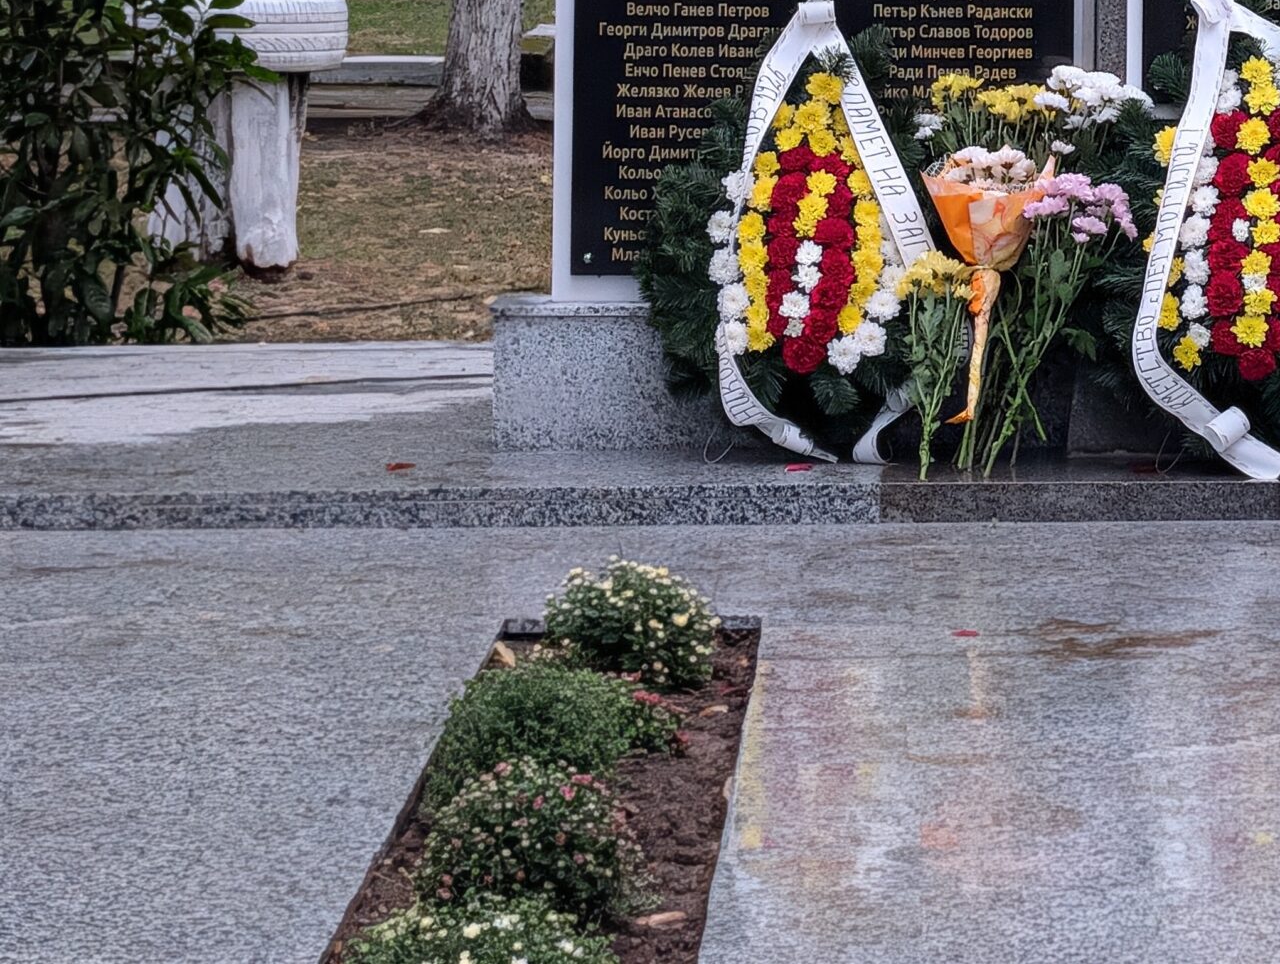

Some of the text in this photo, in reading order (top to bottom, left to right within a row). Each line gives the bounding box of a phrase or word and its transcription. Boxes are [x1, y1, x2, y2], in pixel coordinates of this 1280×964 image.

[626, 2, 769, 20] Велчо Ганев Петров
[873, 4, 1032, 20] Петър Кънев Радански
[599, 22, 647, 40] Георги
[651, 23, 724, 40] Димитров
[884, 24, 1033, 40] тър Славов Тодоров
[624, 43, 667, 60] Драго
[671, 43, 714, 57] Колев
[911, 45, 965, 59] Минчев
[969, 45, 1032, 61] Георгиев
[625, 63, 746, 78] Енчо Пенев Стоя
[889, 65, 923, 80] Ради
[974, 65, 1016, 80] Радев
[616, 83, 680, 98] Желязко
[684, 84, 731, 98] Желев
[616, 105, 712, 119] Иван Атанасо
[630, 125, 664, 139] Иван
[602, 141, 700, 162] Йорго Димит
[844, 92, 892, 158] ПАМЕТ
[872, 166, 907, 196] НА
[618, 166, 661, 179] Кольо
[604, 186, 648, 200] Кольо
[1136, 316, 1197, 410] КМЕТСТВО
